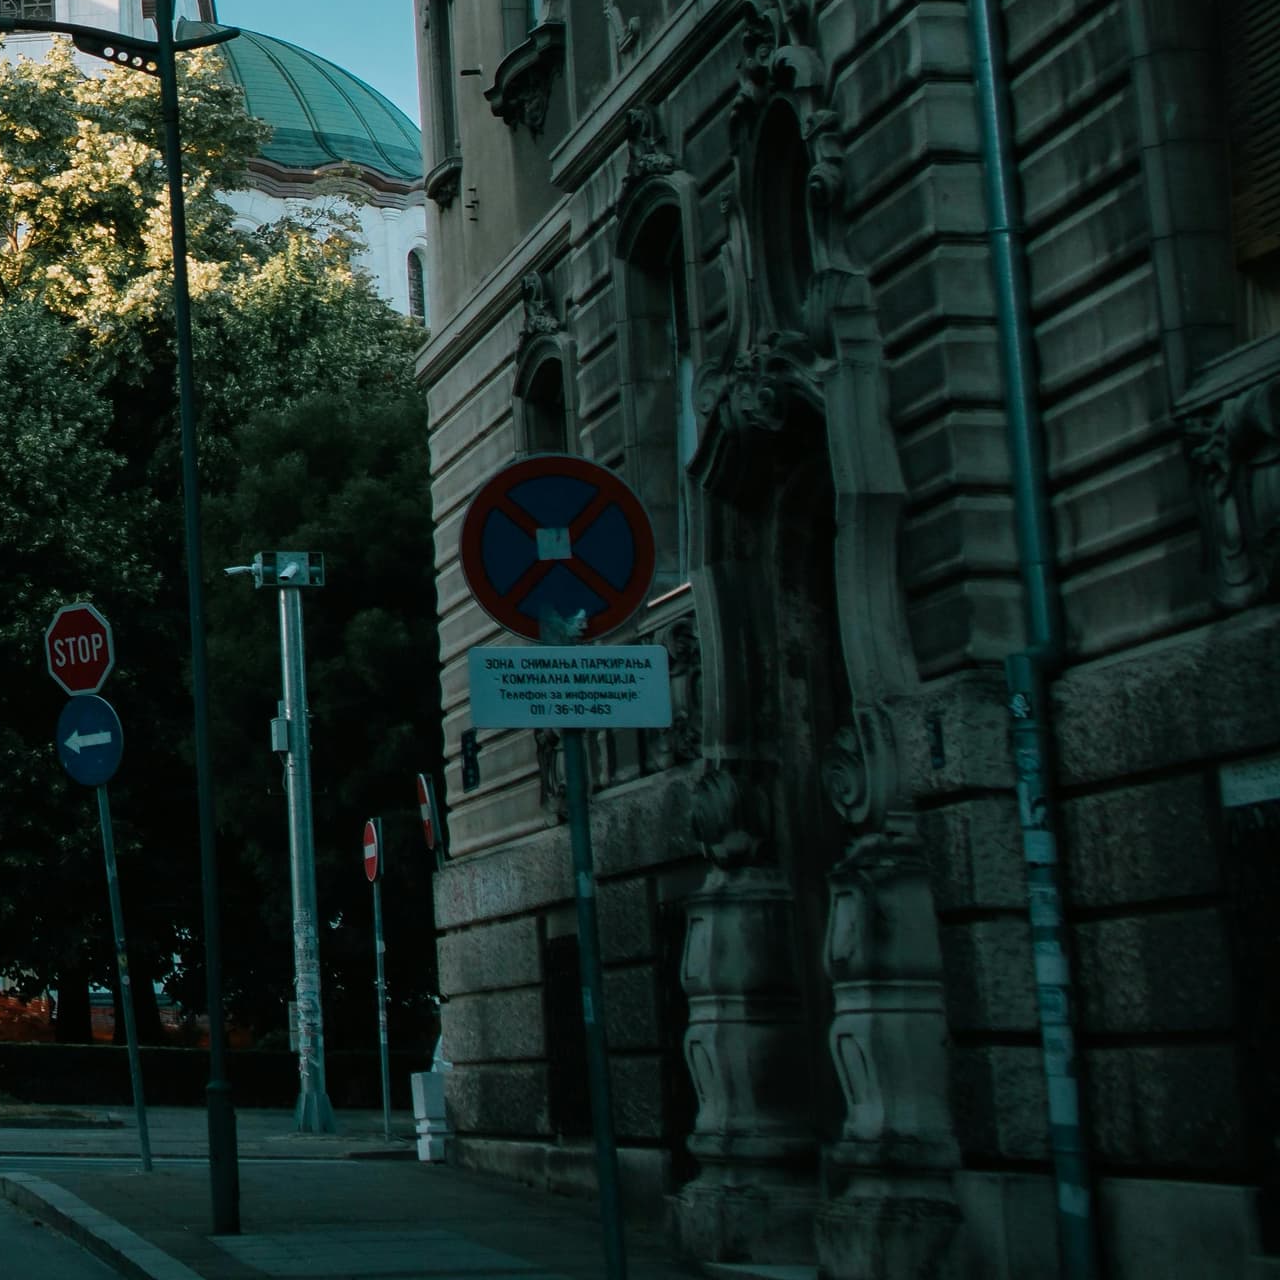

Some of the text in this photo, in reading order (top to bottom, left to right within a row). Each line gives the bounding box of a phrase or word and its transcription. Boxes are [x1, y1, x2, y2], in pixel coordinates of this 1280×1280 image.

[54, 633, 103, 667] STOP
[485, 657, 652, 669] ЗОНА СНИМАЊА ПАРКИРАЊА
[502, 673, 570, 684] КОМУНАЛНА
[573, 673, 636, 685] МИЛИЦИЈА
[499, 689, 547, 701] Телефон
[530, 704, 545, 715] 011
